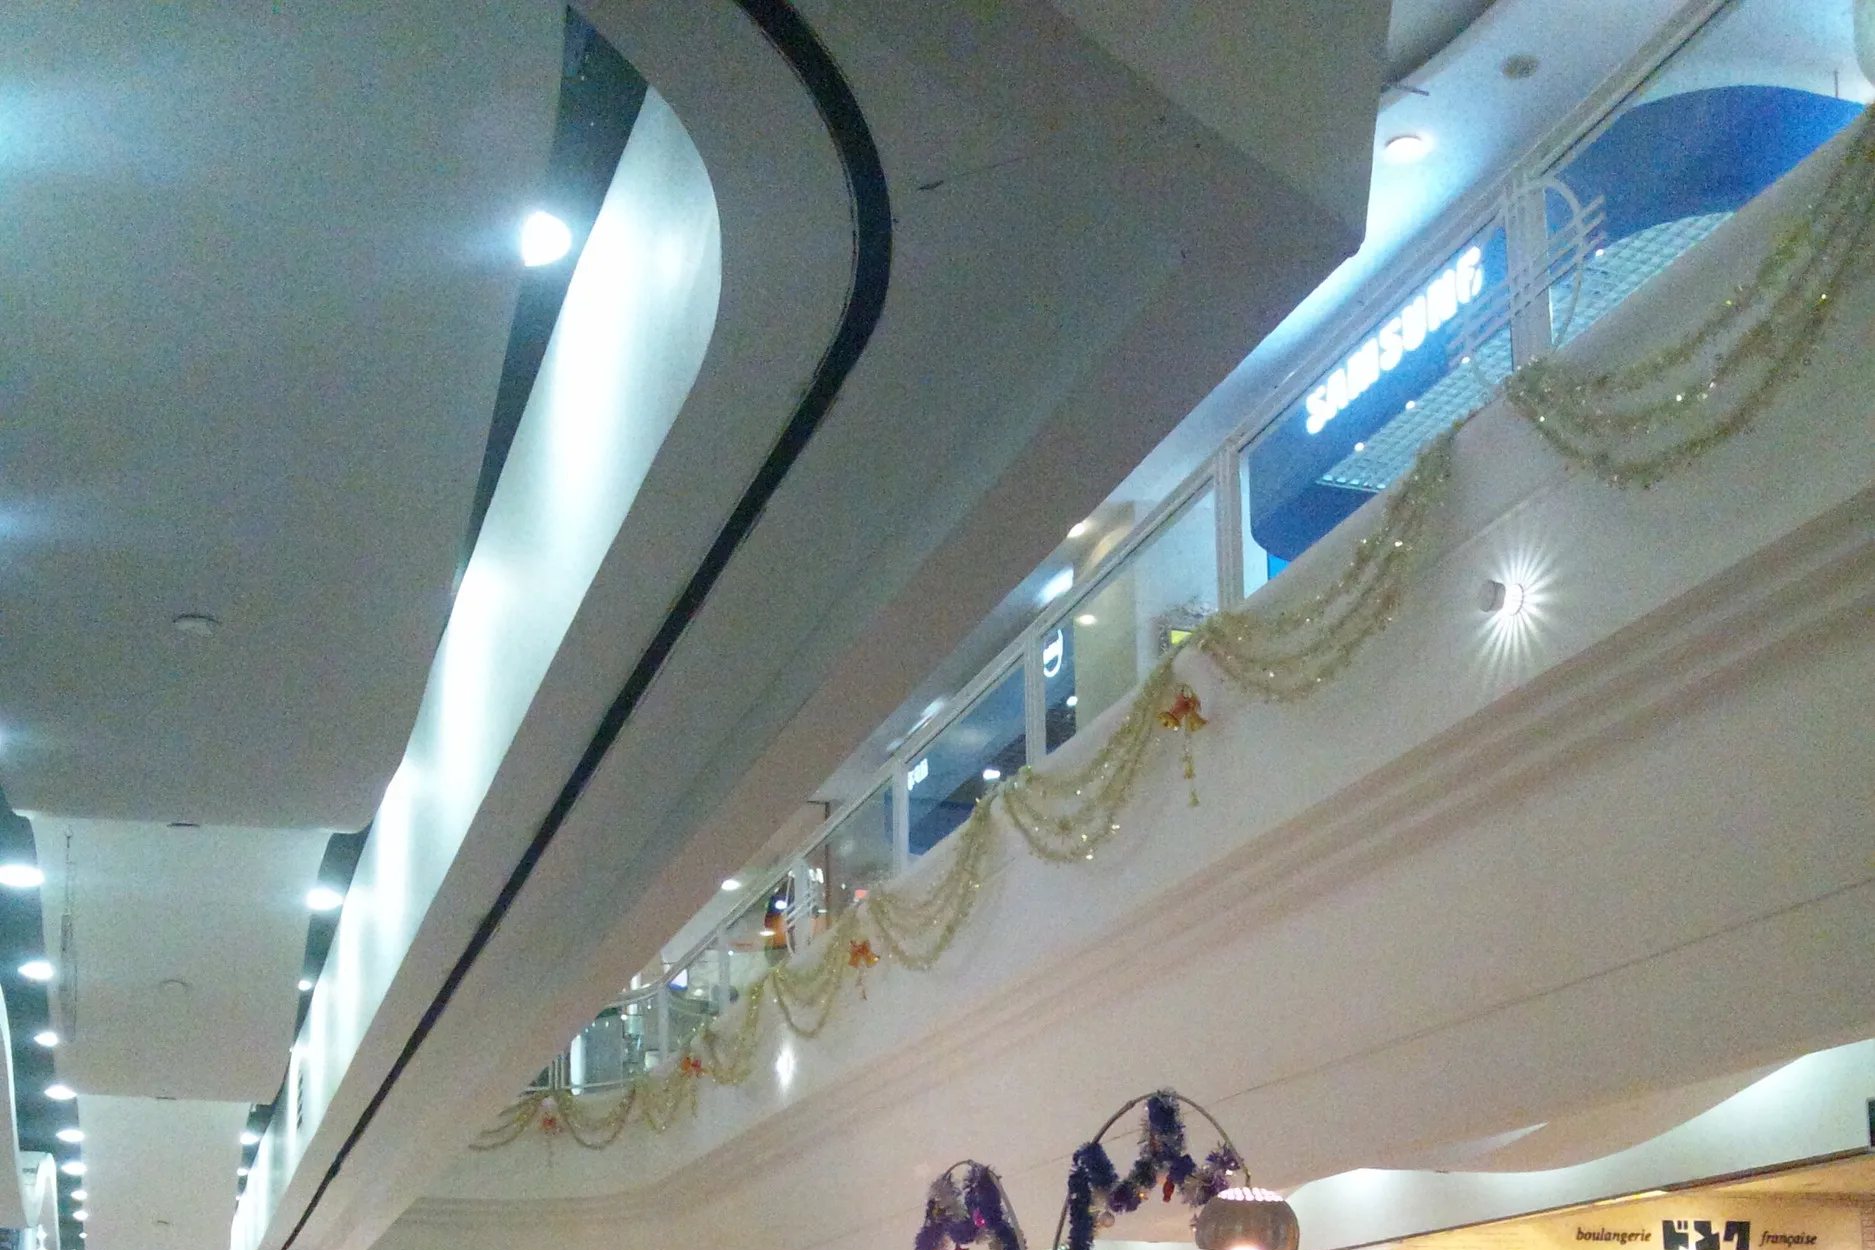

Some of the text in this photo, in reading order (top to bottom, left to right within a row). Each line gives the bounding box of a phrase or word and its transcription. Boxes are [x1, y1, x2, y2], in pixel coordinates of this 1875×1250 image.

[1306, 247, 1483, 434] SAMSUNG
[1576, 1227, 1652, 1245] boulangerie
[1758, 1230, 1818, 1247] française
